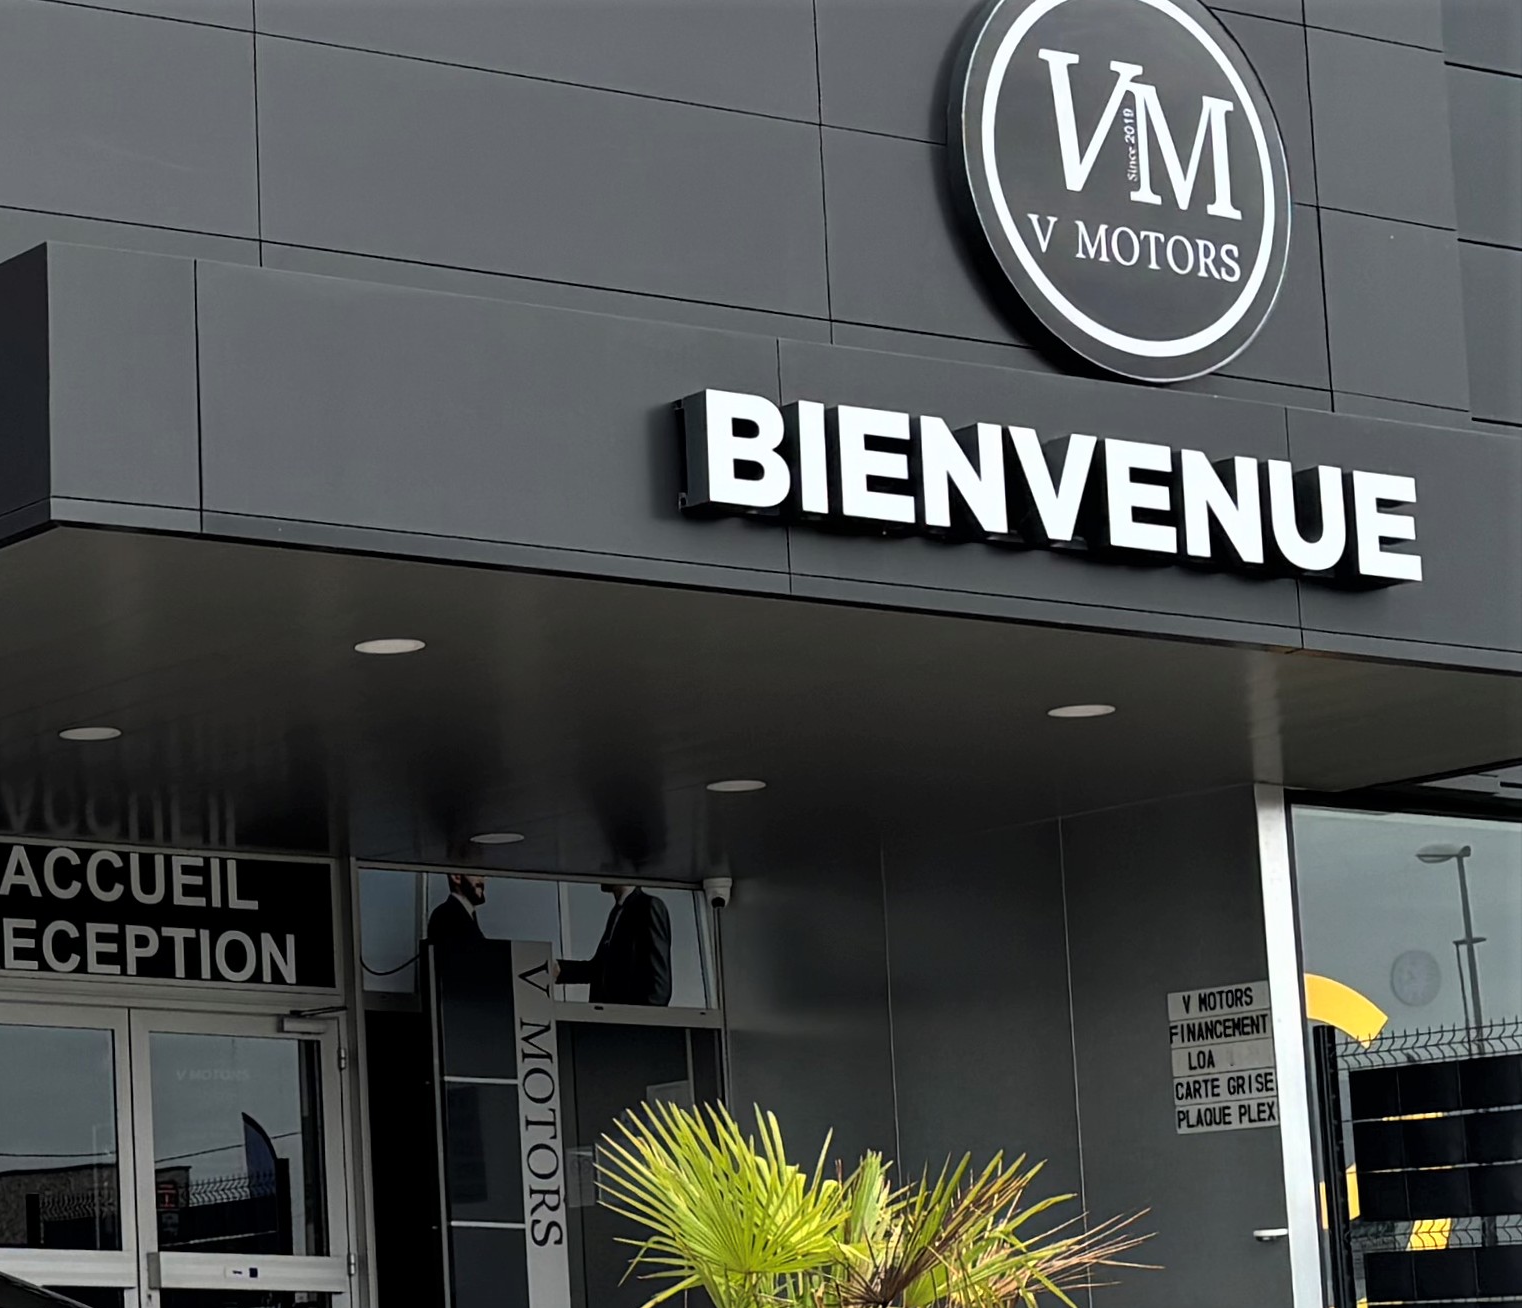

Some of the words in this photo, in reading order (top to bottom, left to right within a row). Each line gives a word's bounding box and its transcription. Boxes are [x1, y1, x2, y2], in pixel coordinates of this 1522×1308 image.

[1038, 48, 1243, 221] VM
[1127, 146, 1138, 182] Since
[1027, 213, 1058, 253] V
[1074, 219, 1242, 283] MOTORS
[704, 387, 1424, 582] BIENVENUE
[517, 959, 551, 999] V
[1182, 994, 1191, 1015] V
[1198, 986, 1254, 1013] MOTORS
[1168, 1013, 1269, 1045] FINANCEMENT
[1187, 1049, 1216, 1071] LOA
[1175, 1077, 1221, 1101] CARTE
[1227, 1072, 1275, 1096] GRISE
[518, 1016, 564, 1249] MOTORS
[1176, 1105, 1232, 1130] PLAQUE
[1238, 1101, 1276, 1124] PLEX
